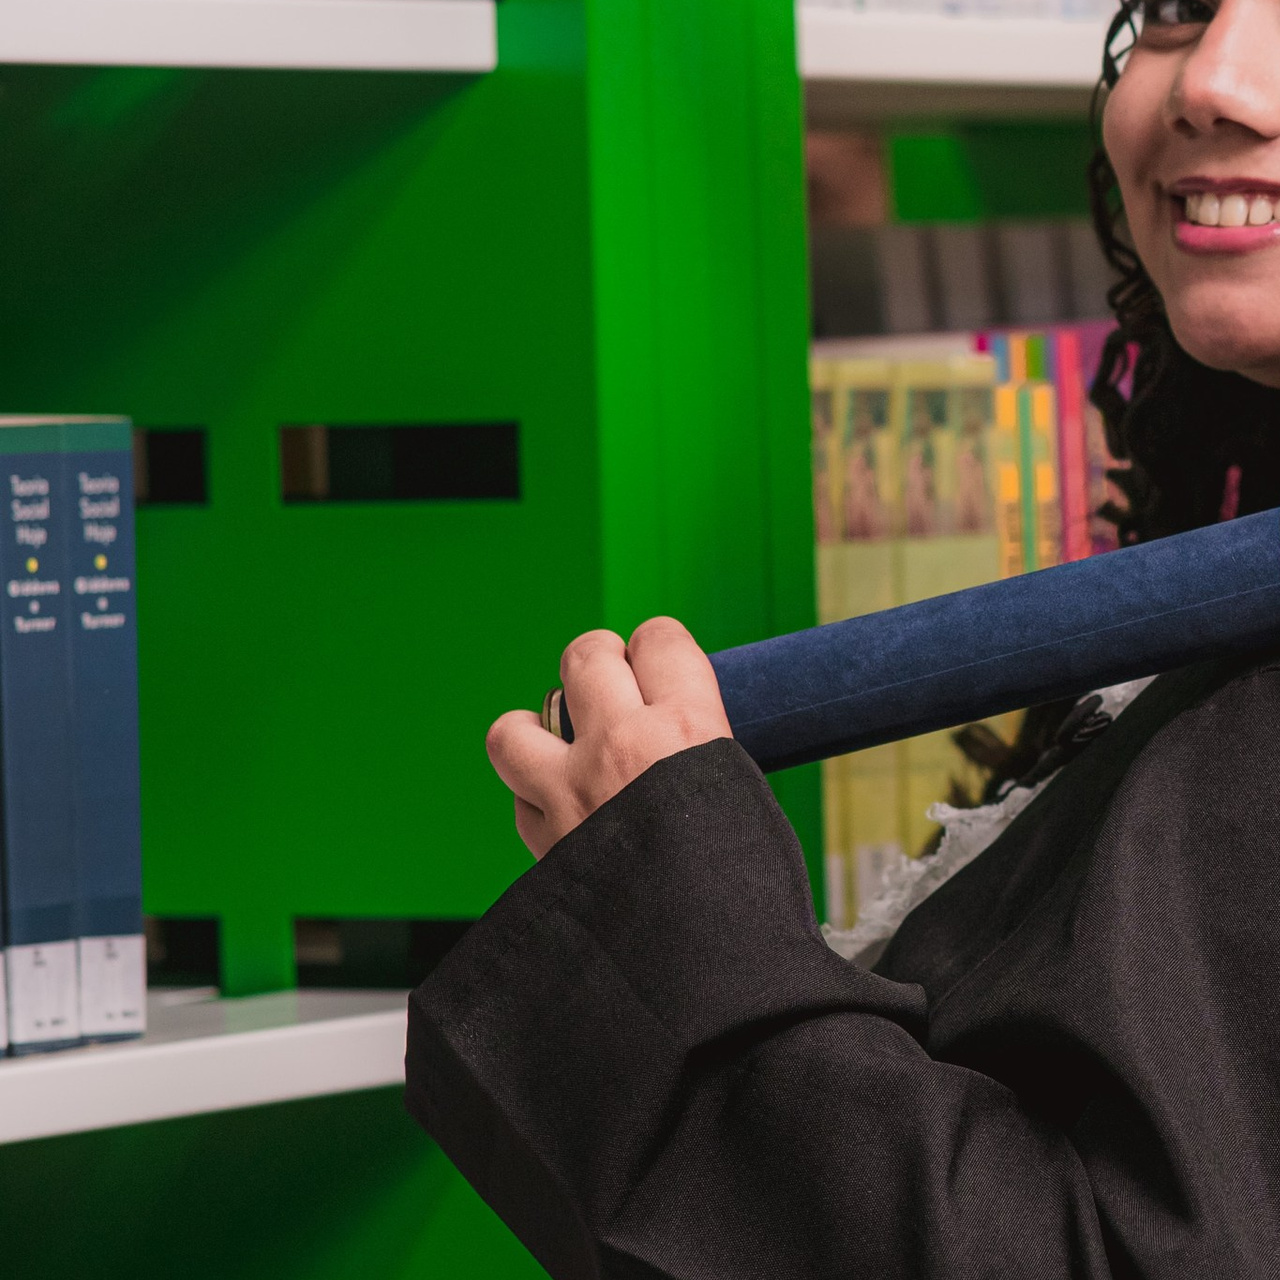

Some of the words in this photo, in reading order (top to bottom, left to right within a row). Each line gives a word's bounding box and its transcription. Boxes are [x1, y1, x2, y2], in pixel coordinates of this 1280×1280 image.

[10, 474, 49, 496] Teoria
[78, 472, 120, 494] Teoria
[11, 497, 50, 521] Social
[78, 496, 120, 519] Social
[16, 523, 47, 548] Hoje
[83, 522, 117, 546] Hoje
